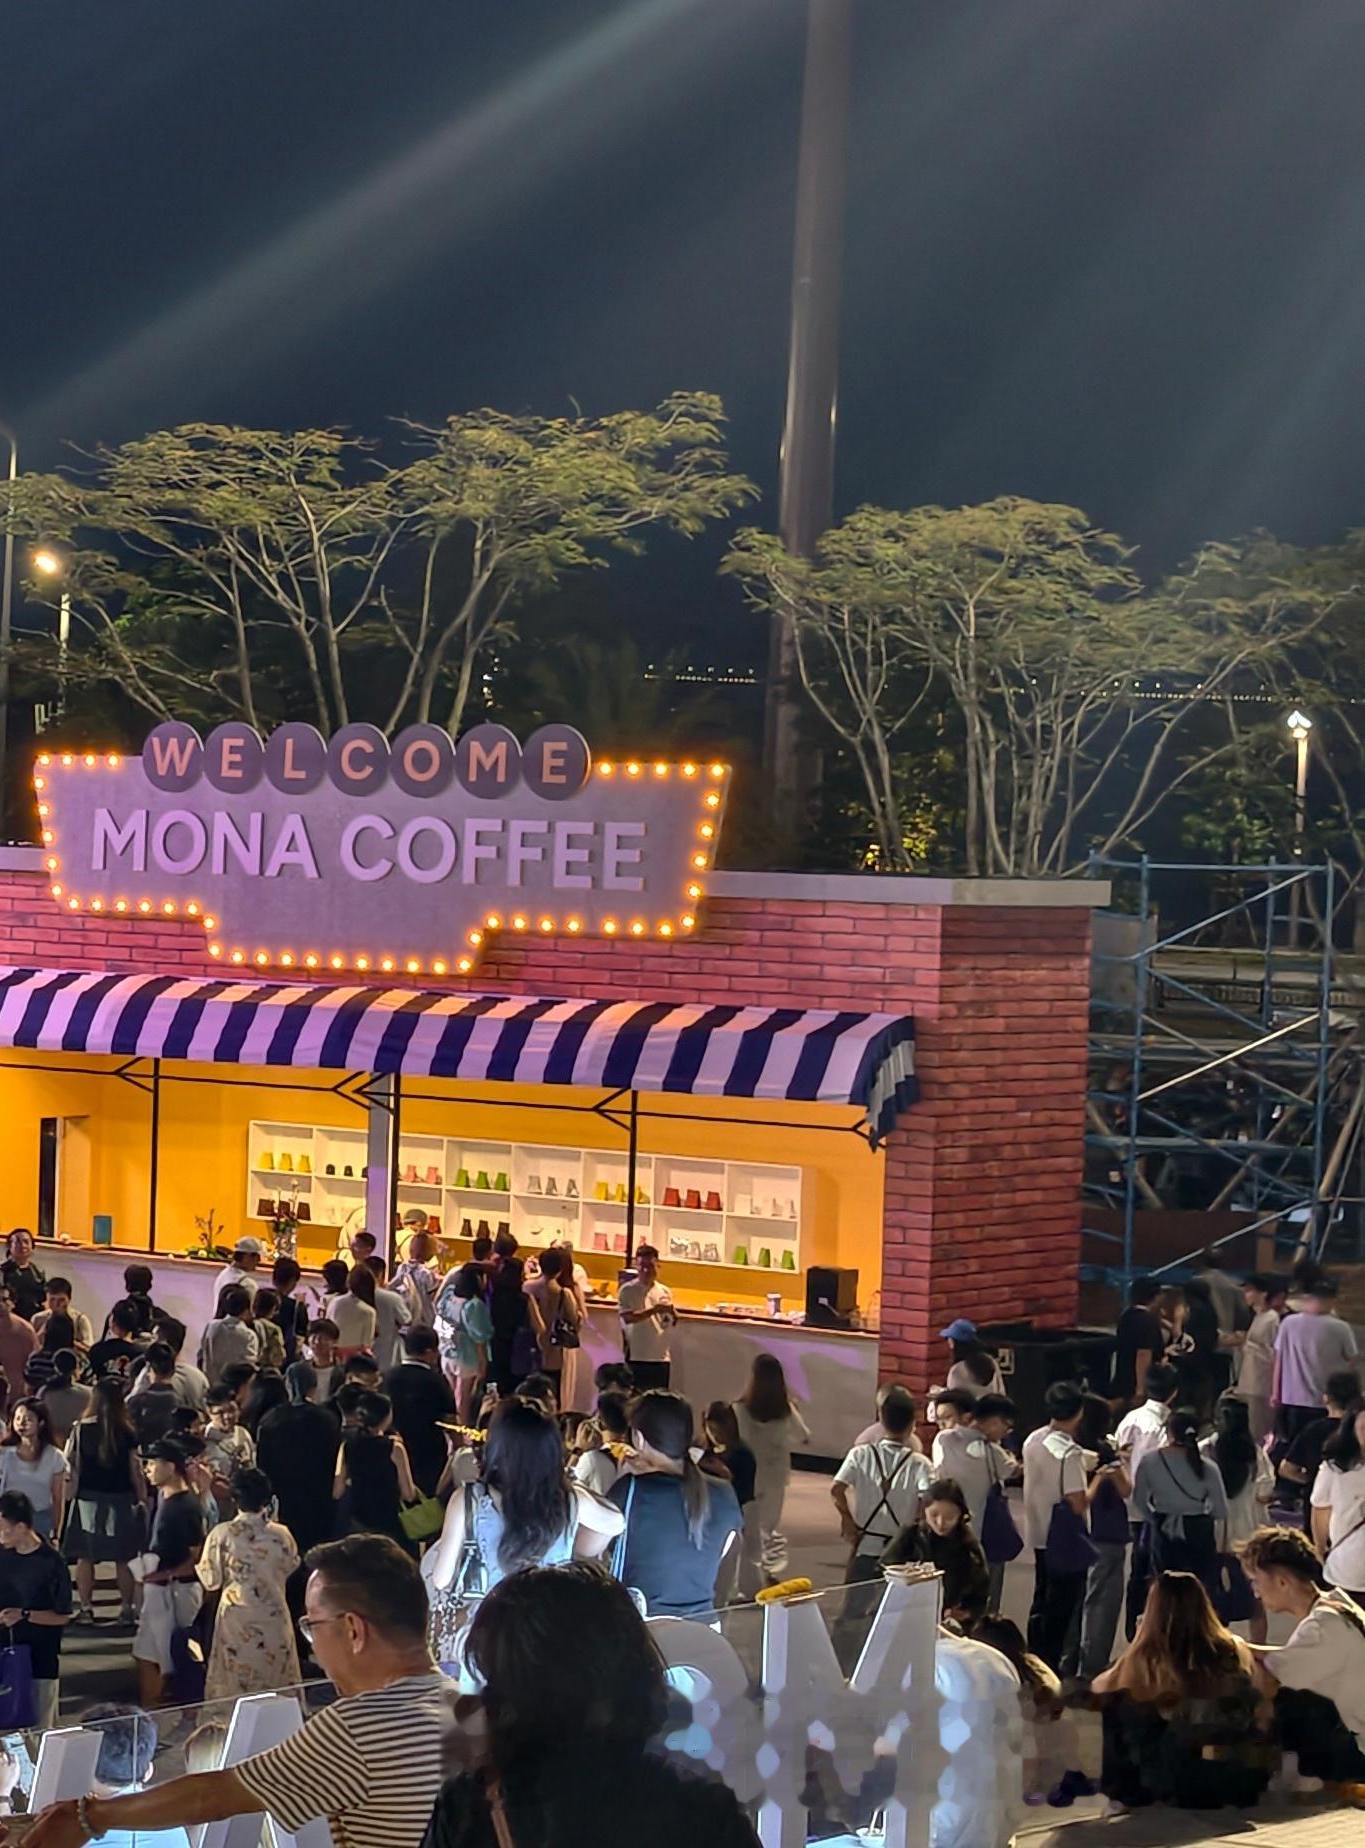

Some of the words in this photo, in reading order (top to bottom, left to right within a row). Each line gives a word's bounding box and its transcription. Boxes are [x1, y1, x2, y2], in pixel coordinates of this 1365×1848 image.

[151, 736, 569, 785] WELCOME
[91, 807, 320, 879] MONA
[340, 812, 646, 892] COFFEE
